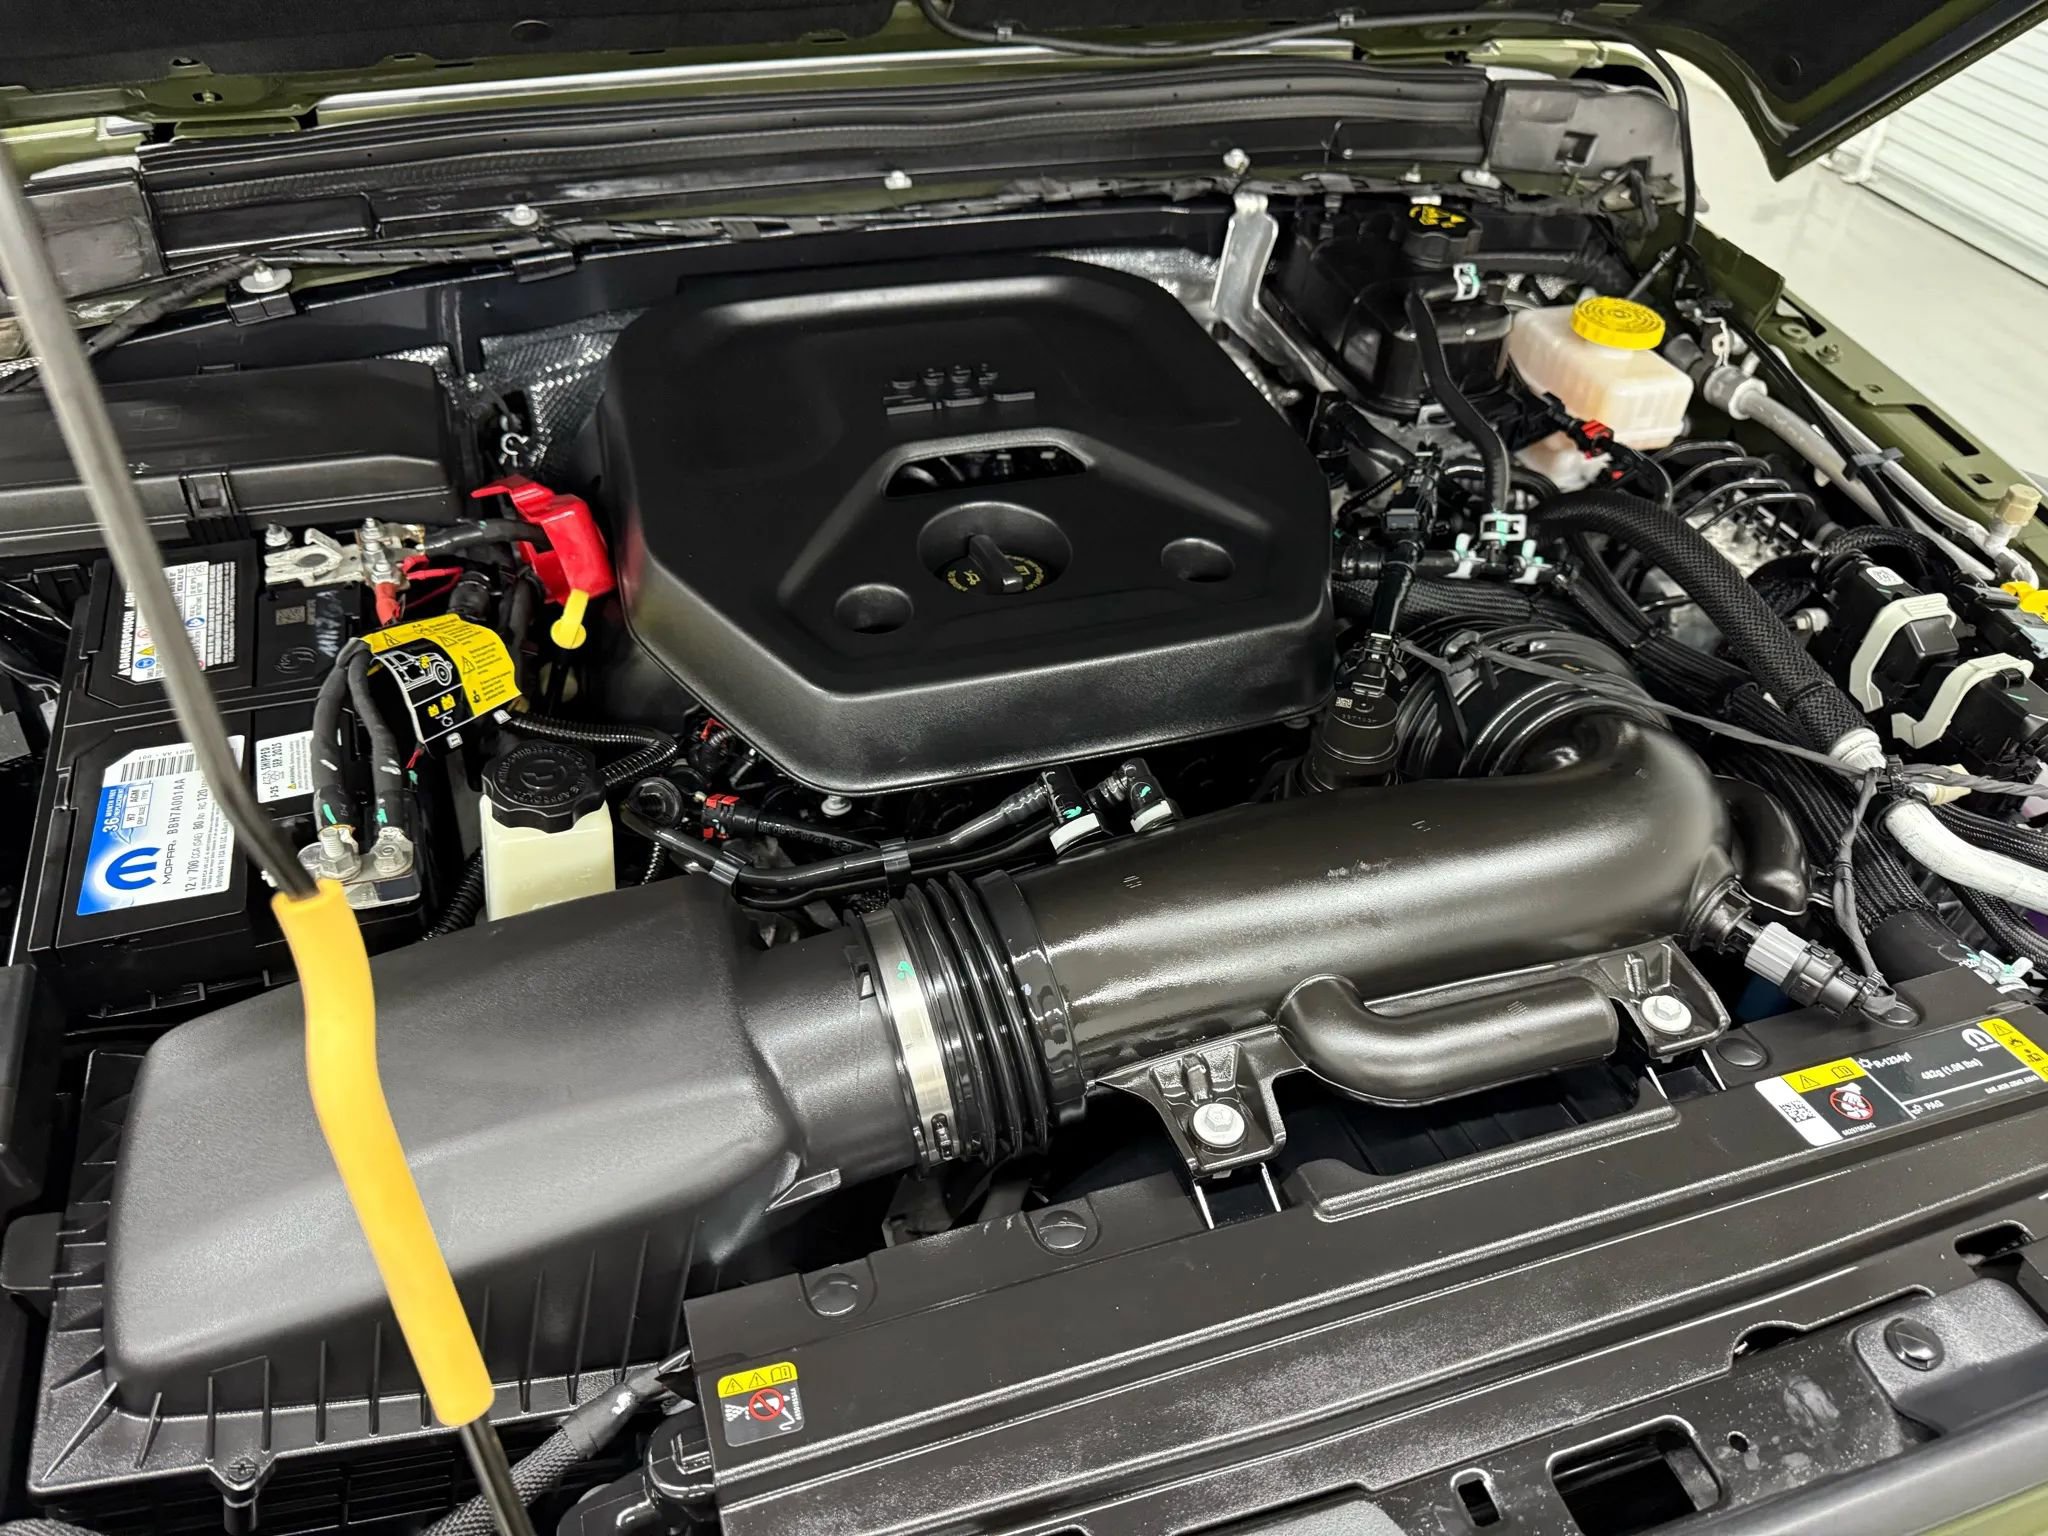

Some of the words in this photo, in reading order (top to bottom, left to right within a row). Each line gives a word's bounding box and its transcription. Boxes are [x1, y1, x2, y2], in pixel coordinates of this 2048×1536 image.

[260, 747, 271, 770] SHIPPED
[108, 789, 116, 799] FREE
[130, 789, 140, 802] AGM
[197, 789, 208, 801] 120
[105, 800, 114, 817] MONTH
[102, 818, 120, 832] 36
[193, 820, 204, 830] 80
[192, 832, 204, 846] (SAE)
[191, 847, 201, 859] CCA
[187, 860, 199, 874] 700
[215, 866, 225, 888] Distributed
[185, 882, 196, 892] 12
[1924, 1100, 1945, 1111] PAG
